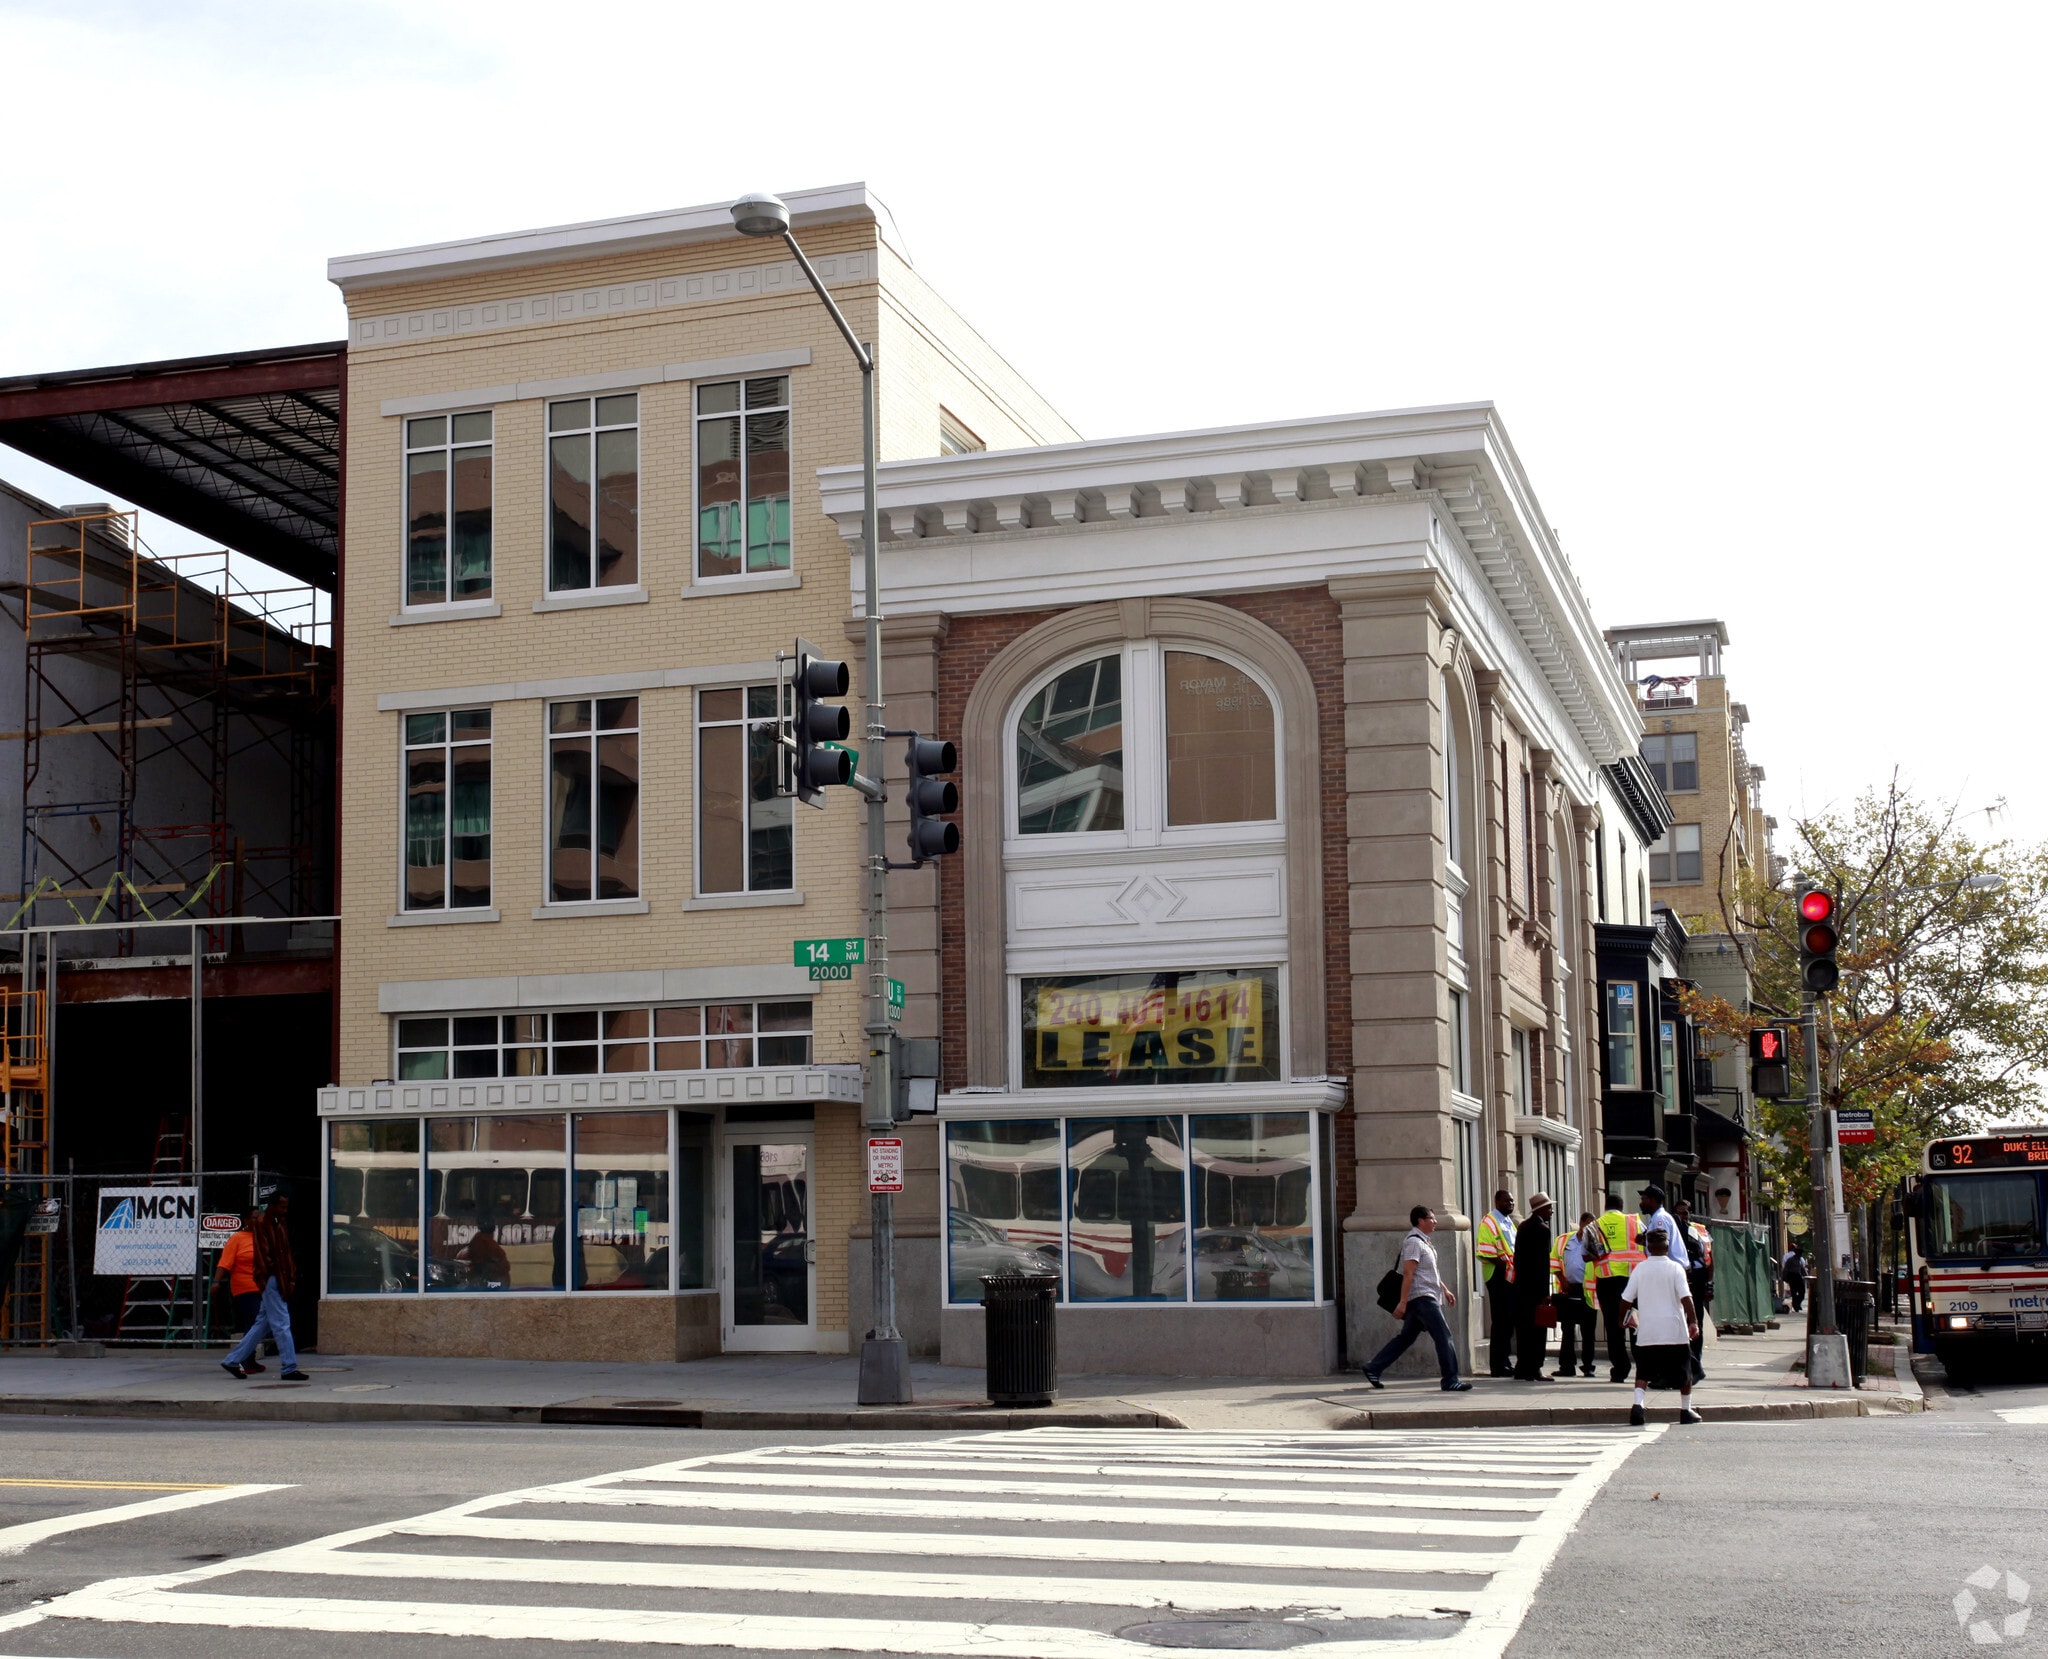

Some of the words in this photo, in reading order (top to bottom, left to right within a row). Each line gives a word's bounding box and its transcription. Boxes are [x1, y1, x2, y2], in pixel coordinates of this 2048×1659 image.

[845, 941, 858, 951] ST
[806, 943, 830, 962] 14
[845, 951, 859, 961] NW
[812, 966, 849, 980] 2000
[888, 981, 893, 1001] U
[1041, 1026, 1257, 1068] LEASE
[2003, 1142, 2028, 1152] DUKE
[1952, 1144, 1973, 1164] 92
[136, 1195, 195, 1220] MCN
[136, 1220, 195, 1229] BUILD
[206, 1218, 238, 1228] DANGER
[1949, 1301, 1978, 1311] 2109
